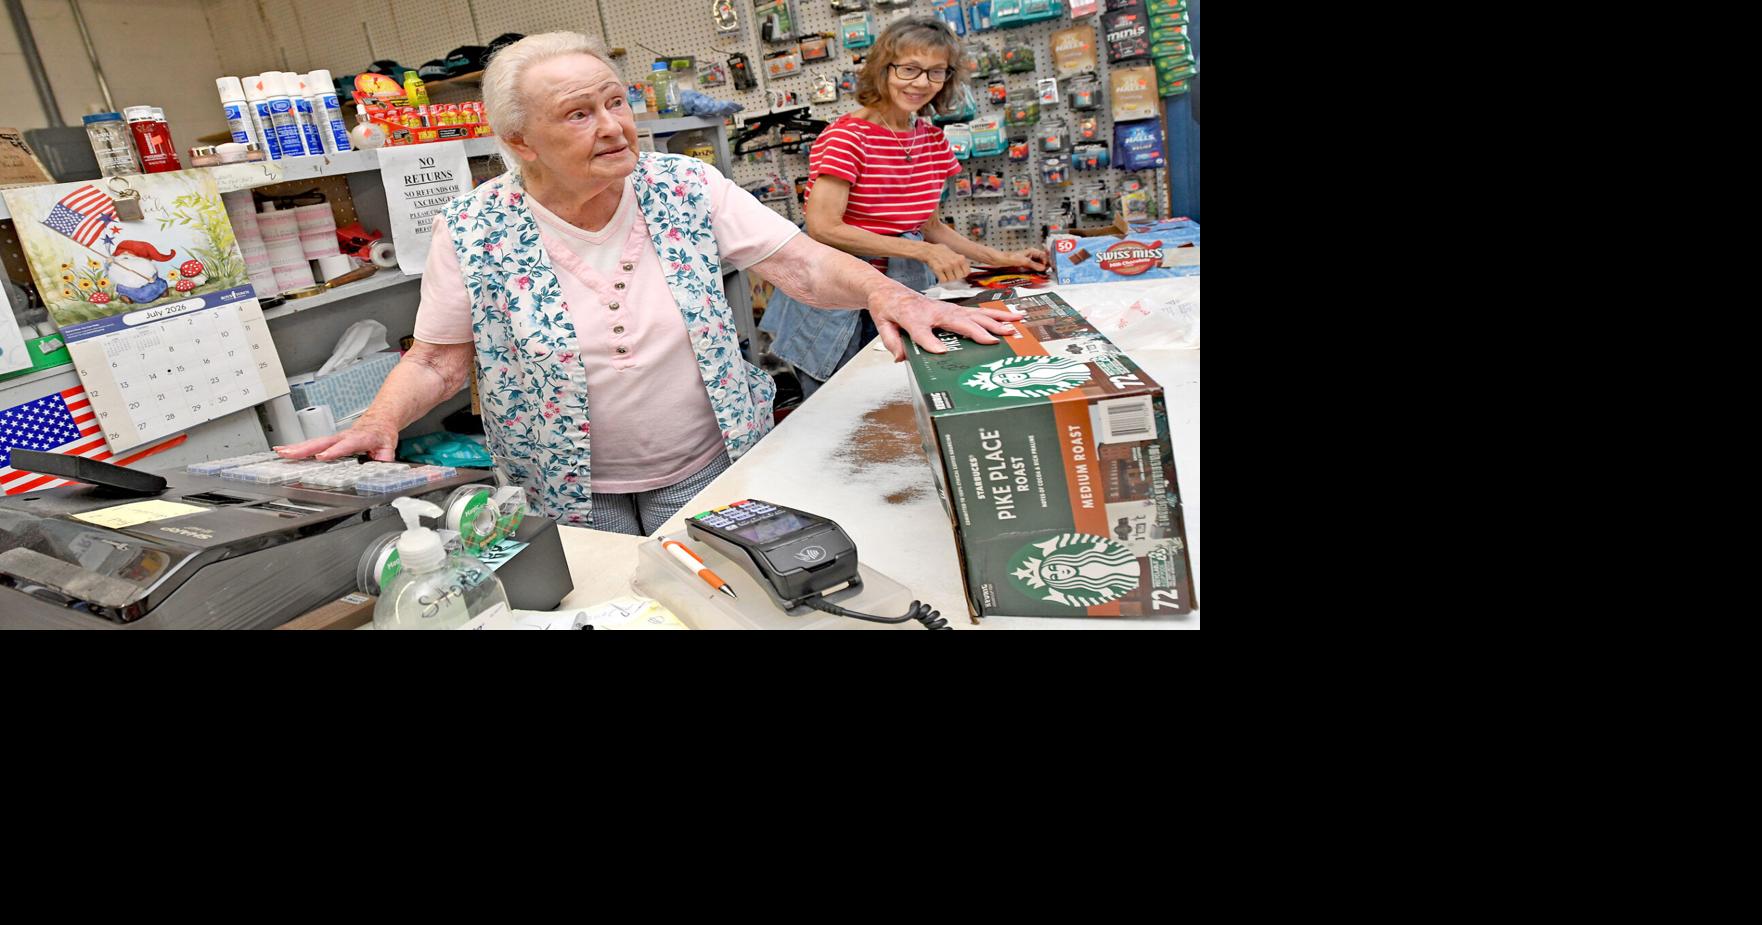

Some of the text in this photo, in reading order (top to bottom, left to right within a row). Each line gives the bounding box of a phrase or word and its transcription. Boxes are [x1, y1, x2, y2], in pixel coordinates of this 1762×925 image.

[1106, 26, 1146, 42] minis
[1124, 134, 1156, 144] HALLS
[419, 157, 435, 166] NO
[404, 170, 453, 184] RETURNS
[416, 187, 448, 196] REFUNDS
[1058, 242, 1073, 250] 50
[1096, 248, 1163, 263] SWISS MISS
[146, 305, 186, 319] July 2026
[1109, 372, 1146, 390] 72
[980, 430, 1016, 520] PIKE PLACE
[1010, 456, 1030, 492] ROAST
[1068, 426, 1094, 508] MEDIUM ROAST
[970, 457, 986, 500] STARBUCKS
[1034, 470, 1043, 486] COCOA
[1151, 589, 1180, 610] 72
